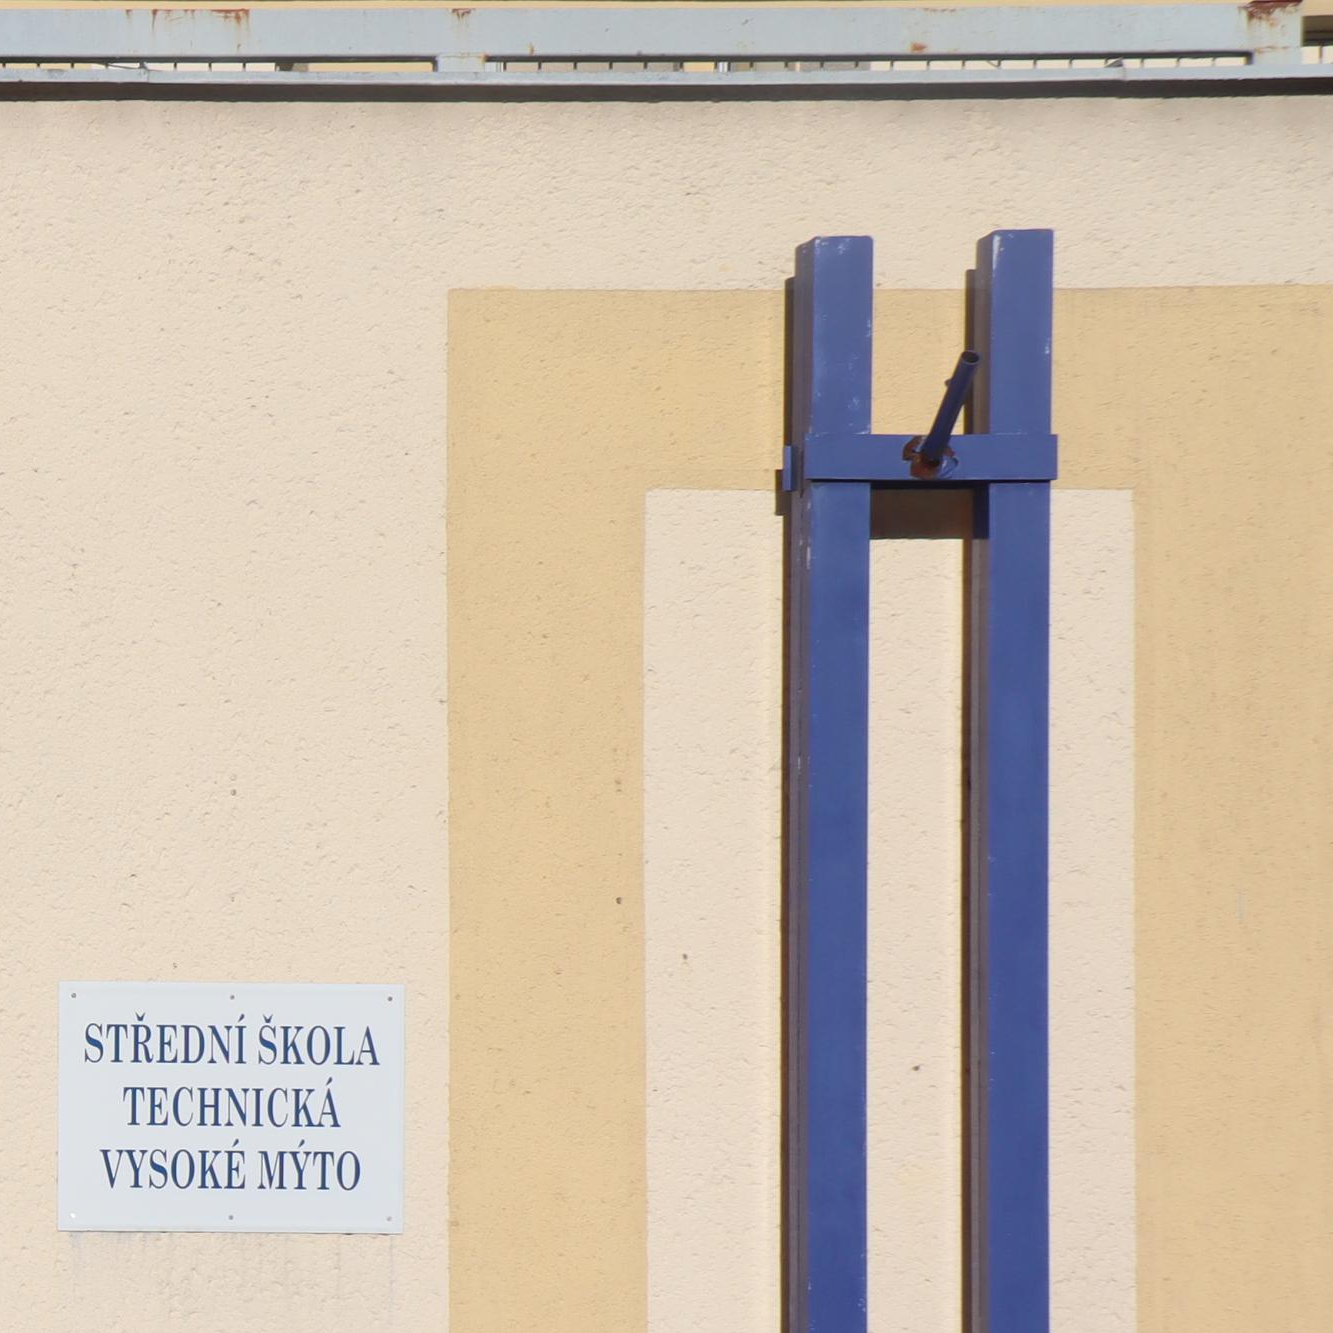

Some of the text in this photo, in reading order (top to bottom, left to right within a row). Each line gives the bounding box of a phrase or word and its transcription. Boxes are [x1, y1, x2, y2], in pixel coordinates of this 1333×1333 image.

[84, 1012, 381, 1066] STŘEDNÍ ŠKOLA
[122, 1076, 342, 1128] TECHNICKÁ
[99, 1138, 361, 1191] VYSOKÉ MÝTO
